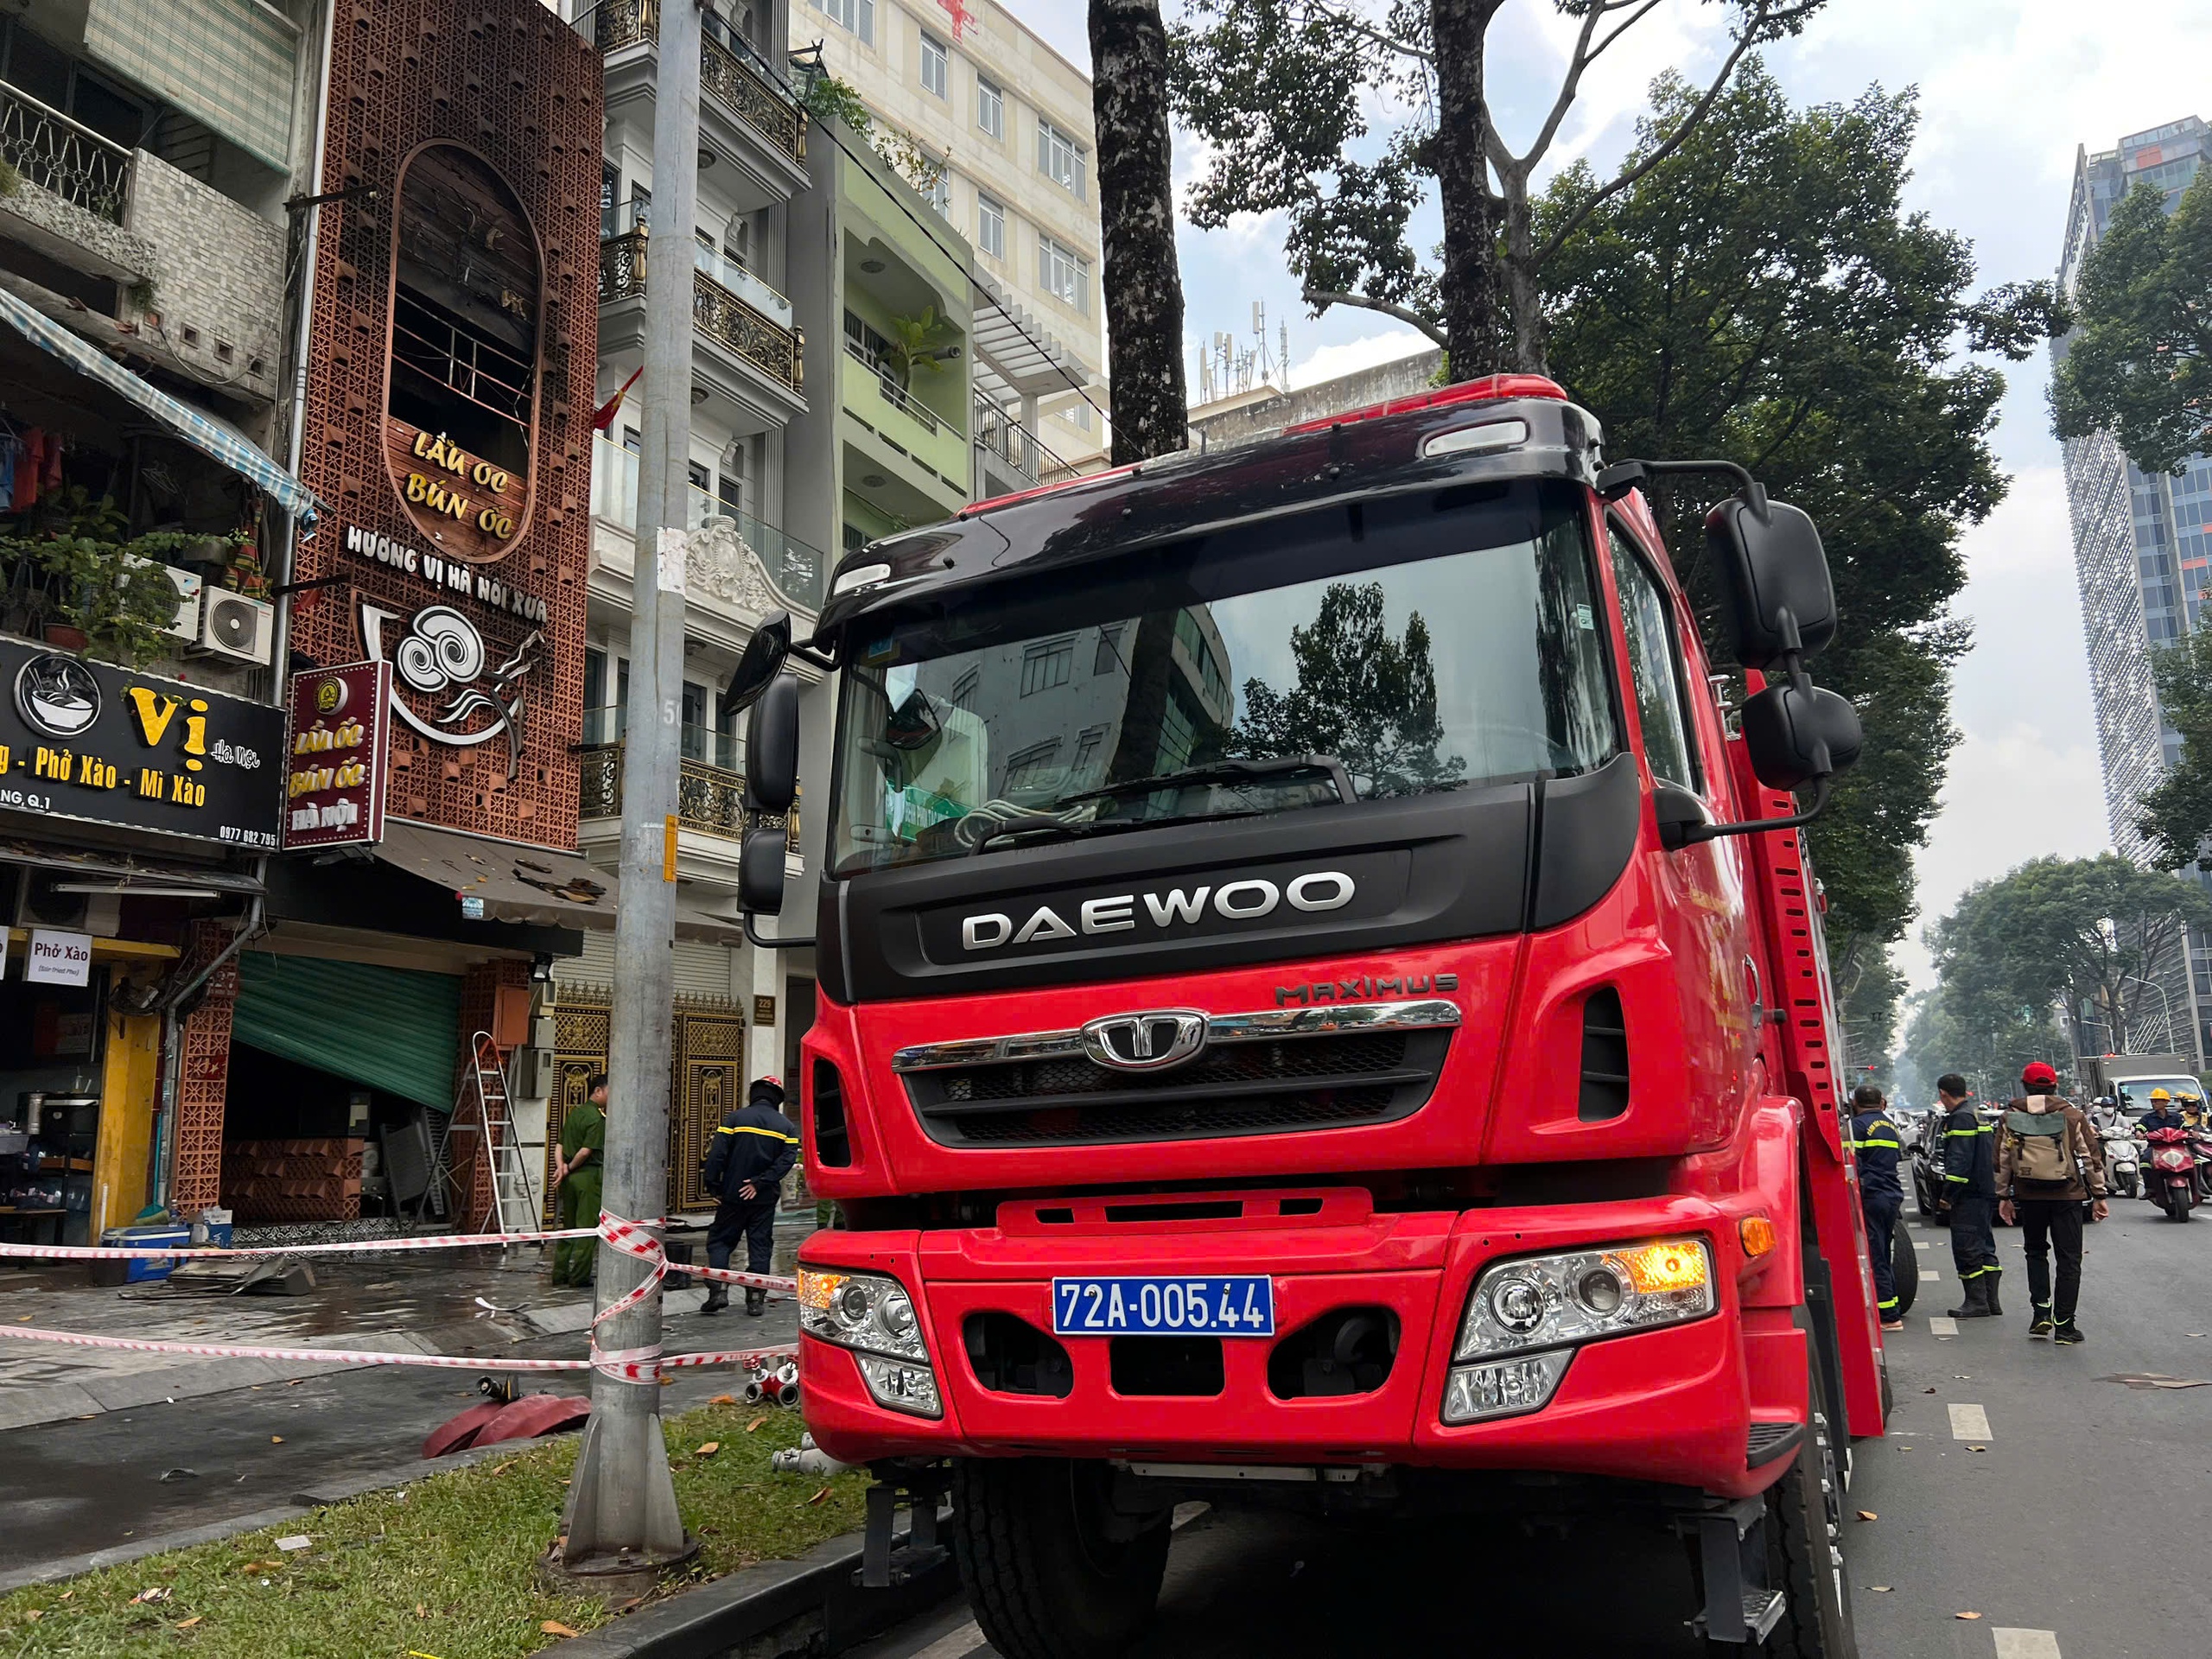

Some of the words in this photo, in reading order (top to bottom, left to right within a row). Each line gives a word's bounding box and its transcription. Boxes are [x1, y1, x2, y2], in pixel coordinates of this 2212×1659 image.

[408, 473, 468, 520] BÚN
[479, 505, 512, 539] ỐC
[346, 524, 416, 573] HƯƠNG
[423, 555, 443, 590] VỊ
[448, 563, 472, 594] HÀ
[477, 576, 507, 613] NỘI
[512, 589, 548, 623] XƯA
[130, 687, 209, 772] Vị
[333, 716, 365, 749] ỐC
[210, 739, 234, 764] Hà
[234, 746, 261, 769] Nội
[35, 747, 73, 781] Phở
[79, 754, 117, 790] Xào
[140, 768, 163, 799] Mì
[172, 773, 206, 807] Xào
[288, 764, 335, 798] BÚN
[334, 756, 366, 789] ỐC
[27, 794, 50, 810] Q.1
[291, 802, 321, 831] HÀ
[321, 798, 359, 832] NỘI
[219, 825, 241, 841] 0977
[243, 830, 258, 844] 682
[260, 832, 276, 847] 795
[963, 871, 1356, 951] DAEWOO
[35, 942, 62, 958] Phở
[64, 946, 88, 961] Xào
[1274, 972, 1459, 1006] MAXIMUS
[1060, 1282, 1264, 1329] 72A-005.44
